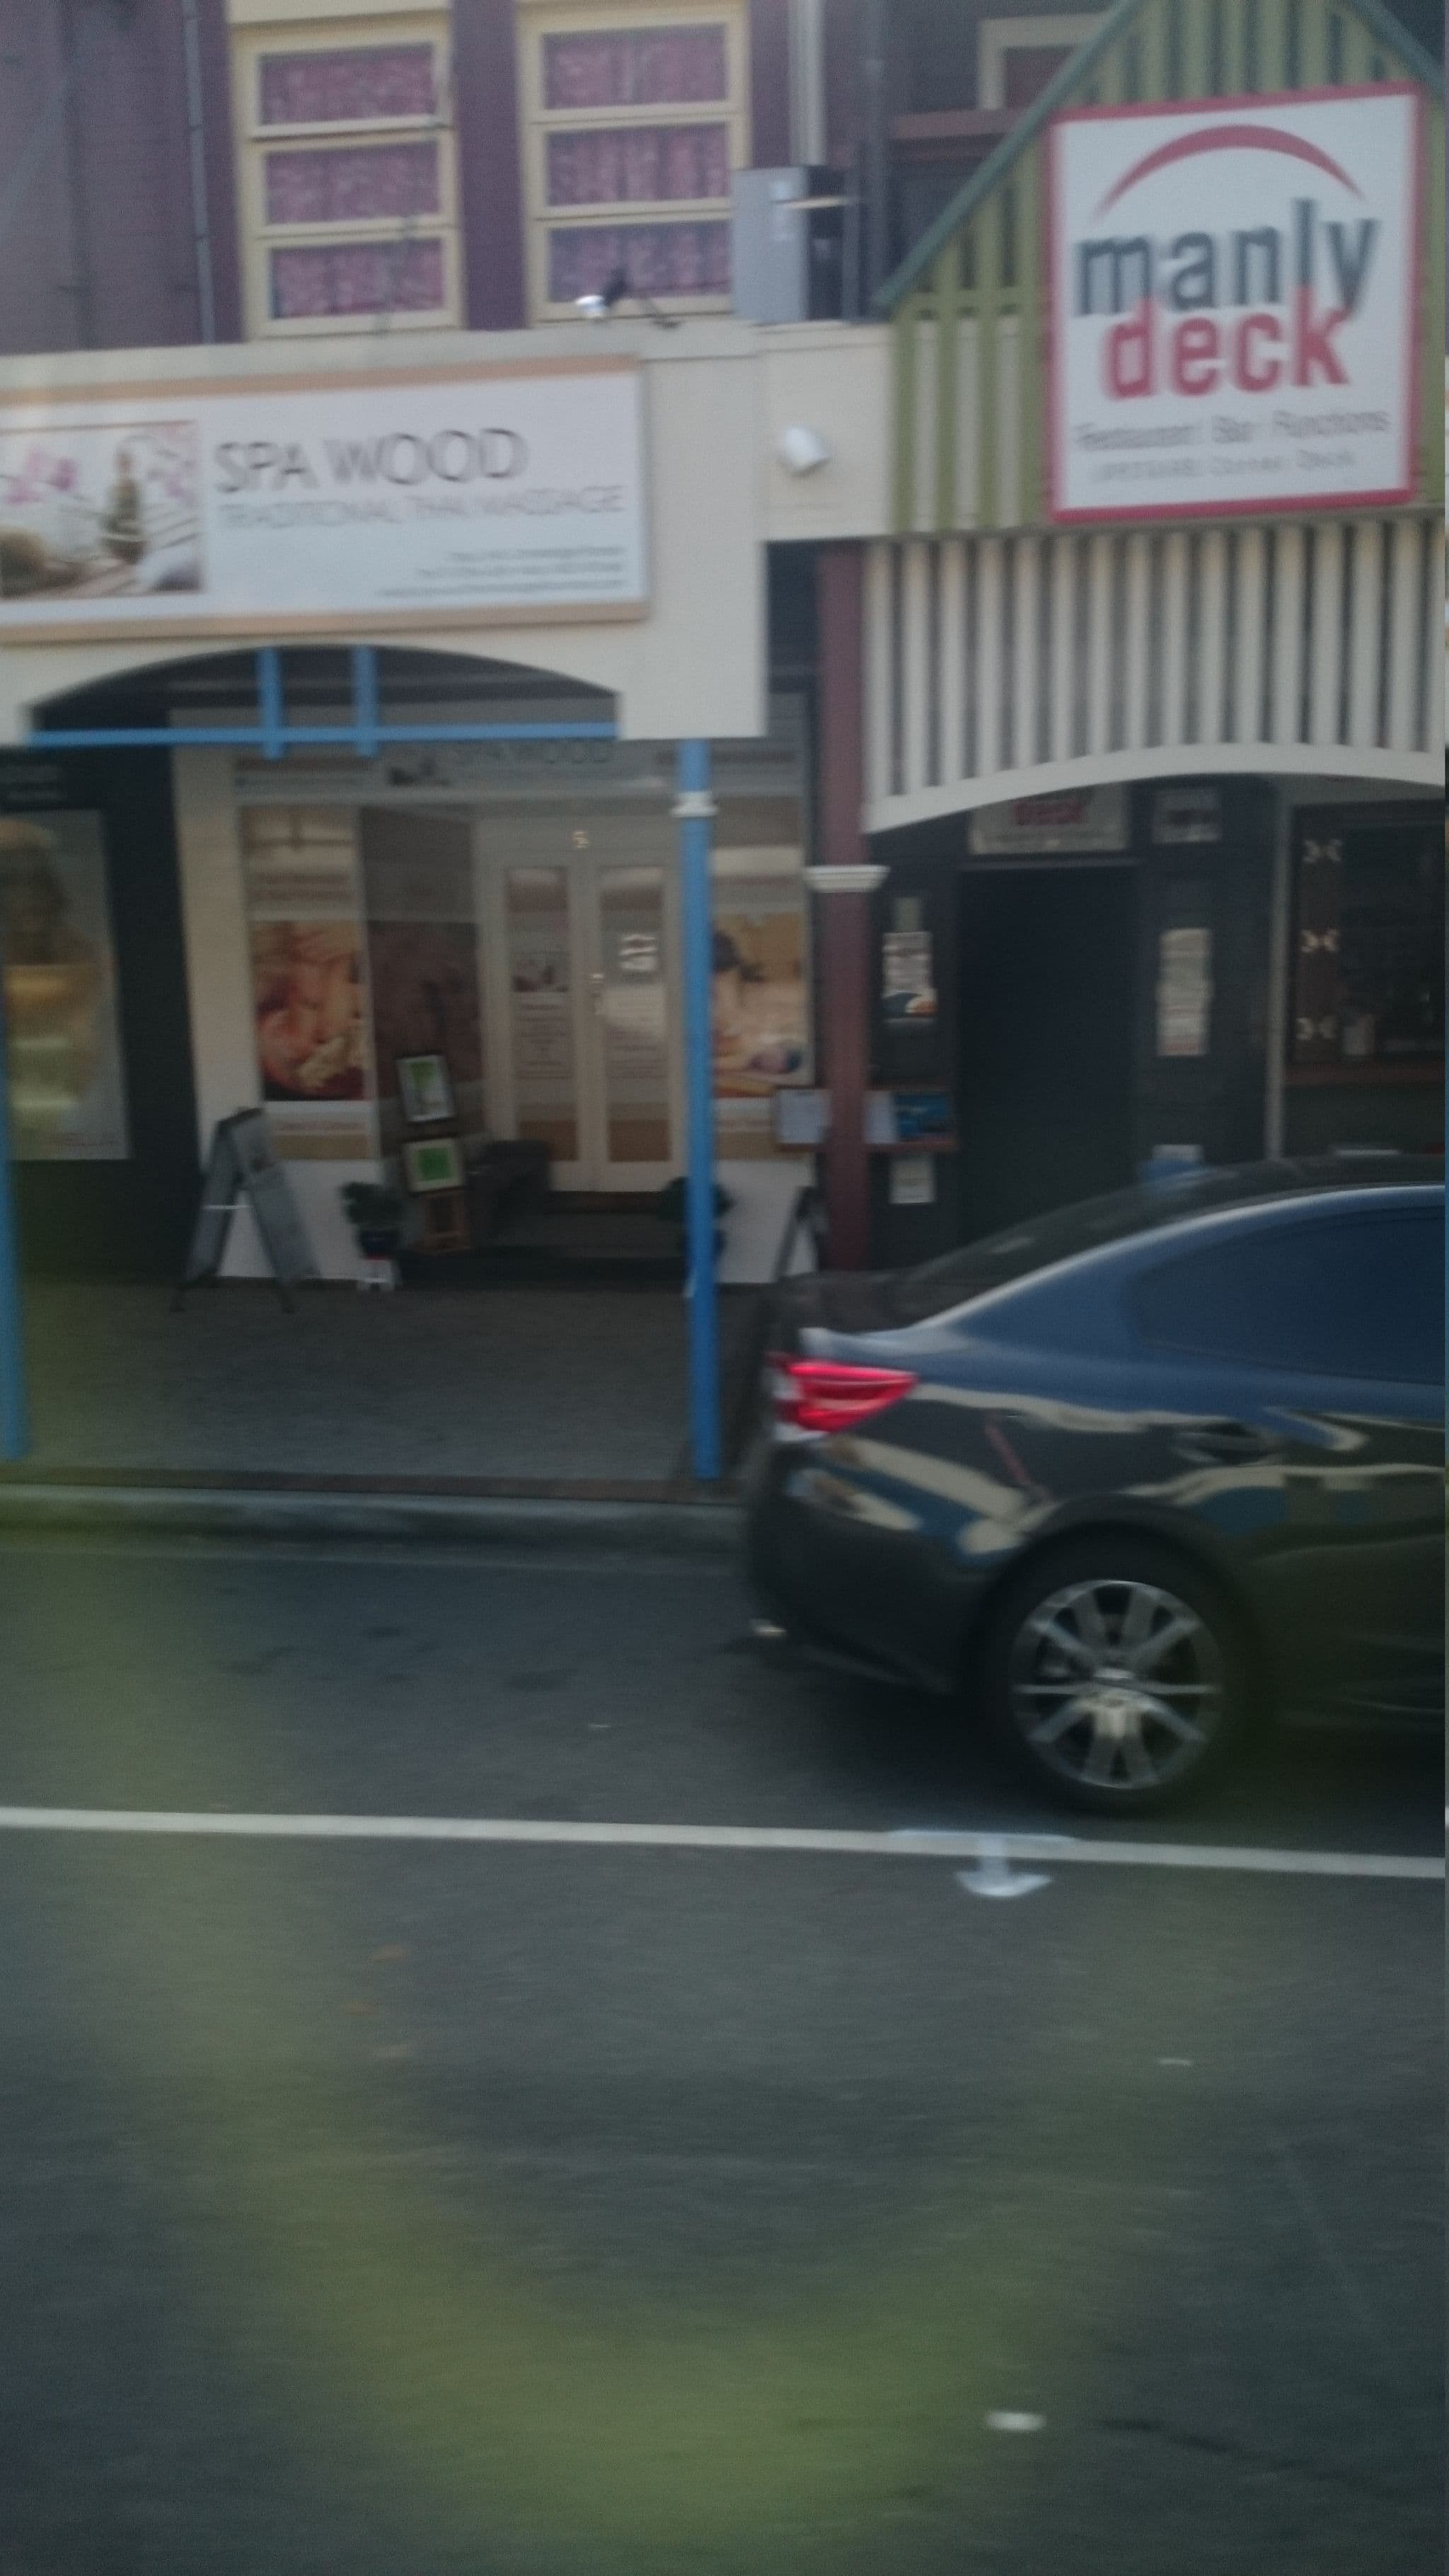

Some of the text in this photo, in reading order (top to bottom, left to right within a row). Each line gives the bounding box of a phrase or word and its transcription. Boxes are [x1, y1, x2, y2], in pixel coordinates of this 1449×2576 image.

[1074, 196, 1380, 323] manly
[1103, 284, 1349, 401] deck
[214, 427, 529, 493] SPA WOOD
